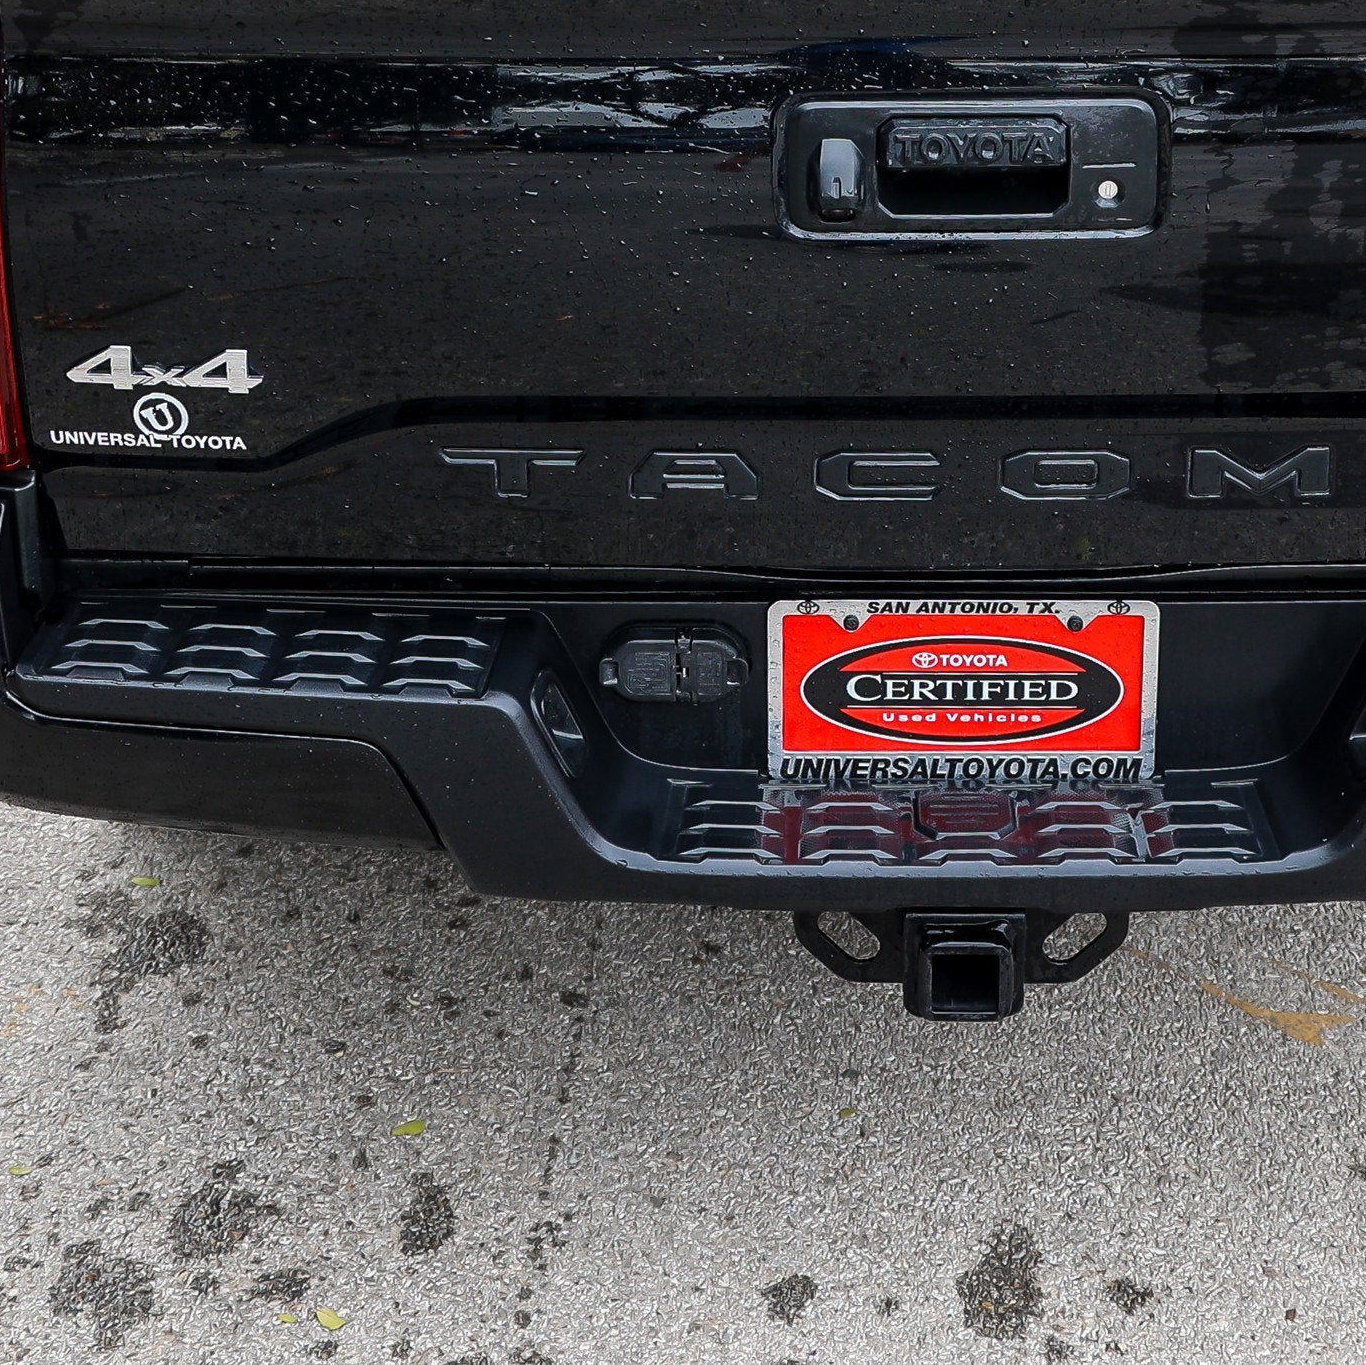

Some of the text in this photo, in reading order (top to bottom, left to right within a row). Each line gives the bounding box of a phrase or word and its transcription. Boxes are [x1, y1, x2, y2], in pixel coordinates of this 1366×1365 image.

[896, 132, 1056, 164] TOYOTA
[66, 345, 263, 394] 4x4
[50, 430, 247, 450] UNIVERSAL TOYOTA
[866, 601, 1060, 614] SAN ANTONIO, TX.
[940, 653, 1008, 668] TOYOTA
[882, 712, 1043, 723] Used Vehicles
[779, 756, 1146, 780] UNIVERSALTOYOTA.COM
